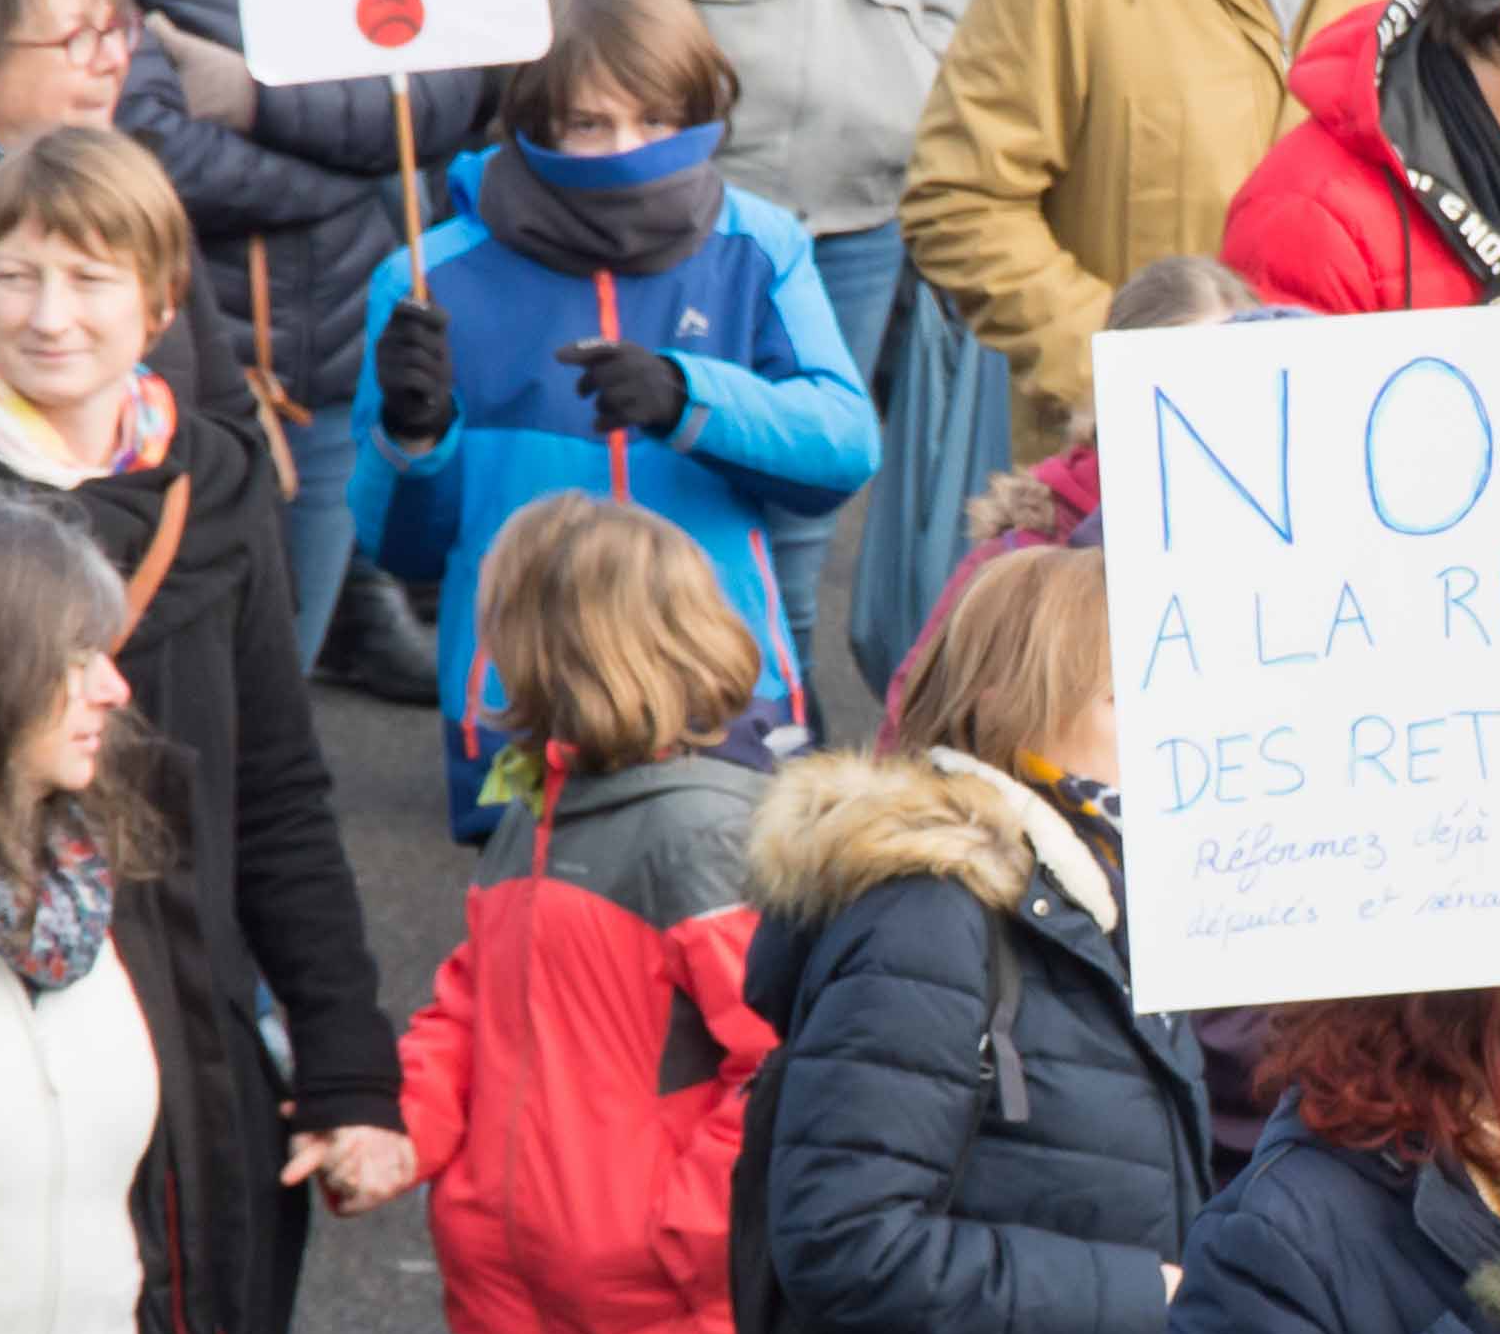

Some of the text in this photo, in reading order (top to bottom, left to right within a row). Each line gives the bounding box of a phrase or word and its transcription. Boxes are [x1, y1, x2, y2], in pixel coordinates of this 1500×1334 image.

[1142, 593, 1202, 690] A
[1254, 581, 1375, 666] LA
[1155, 724, 1307, 815] DES
[1357, 884, 1399, 922] et
